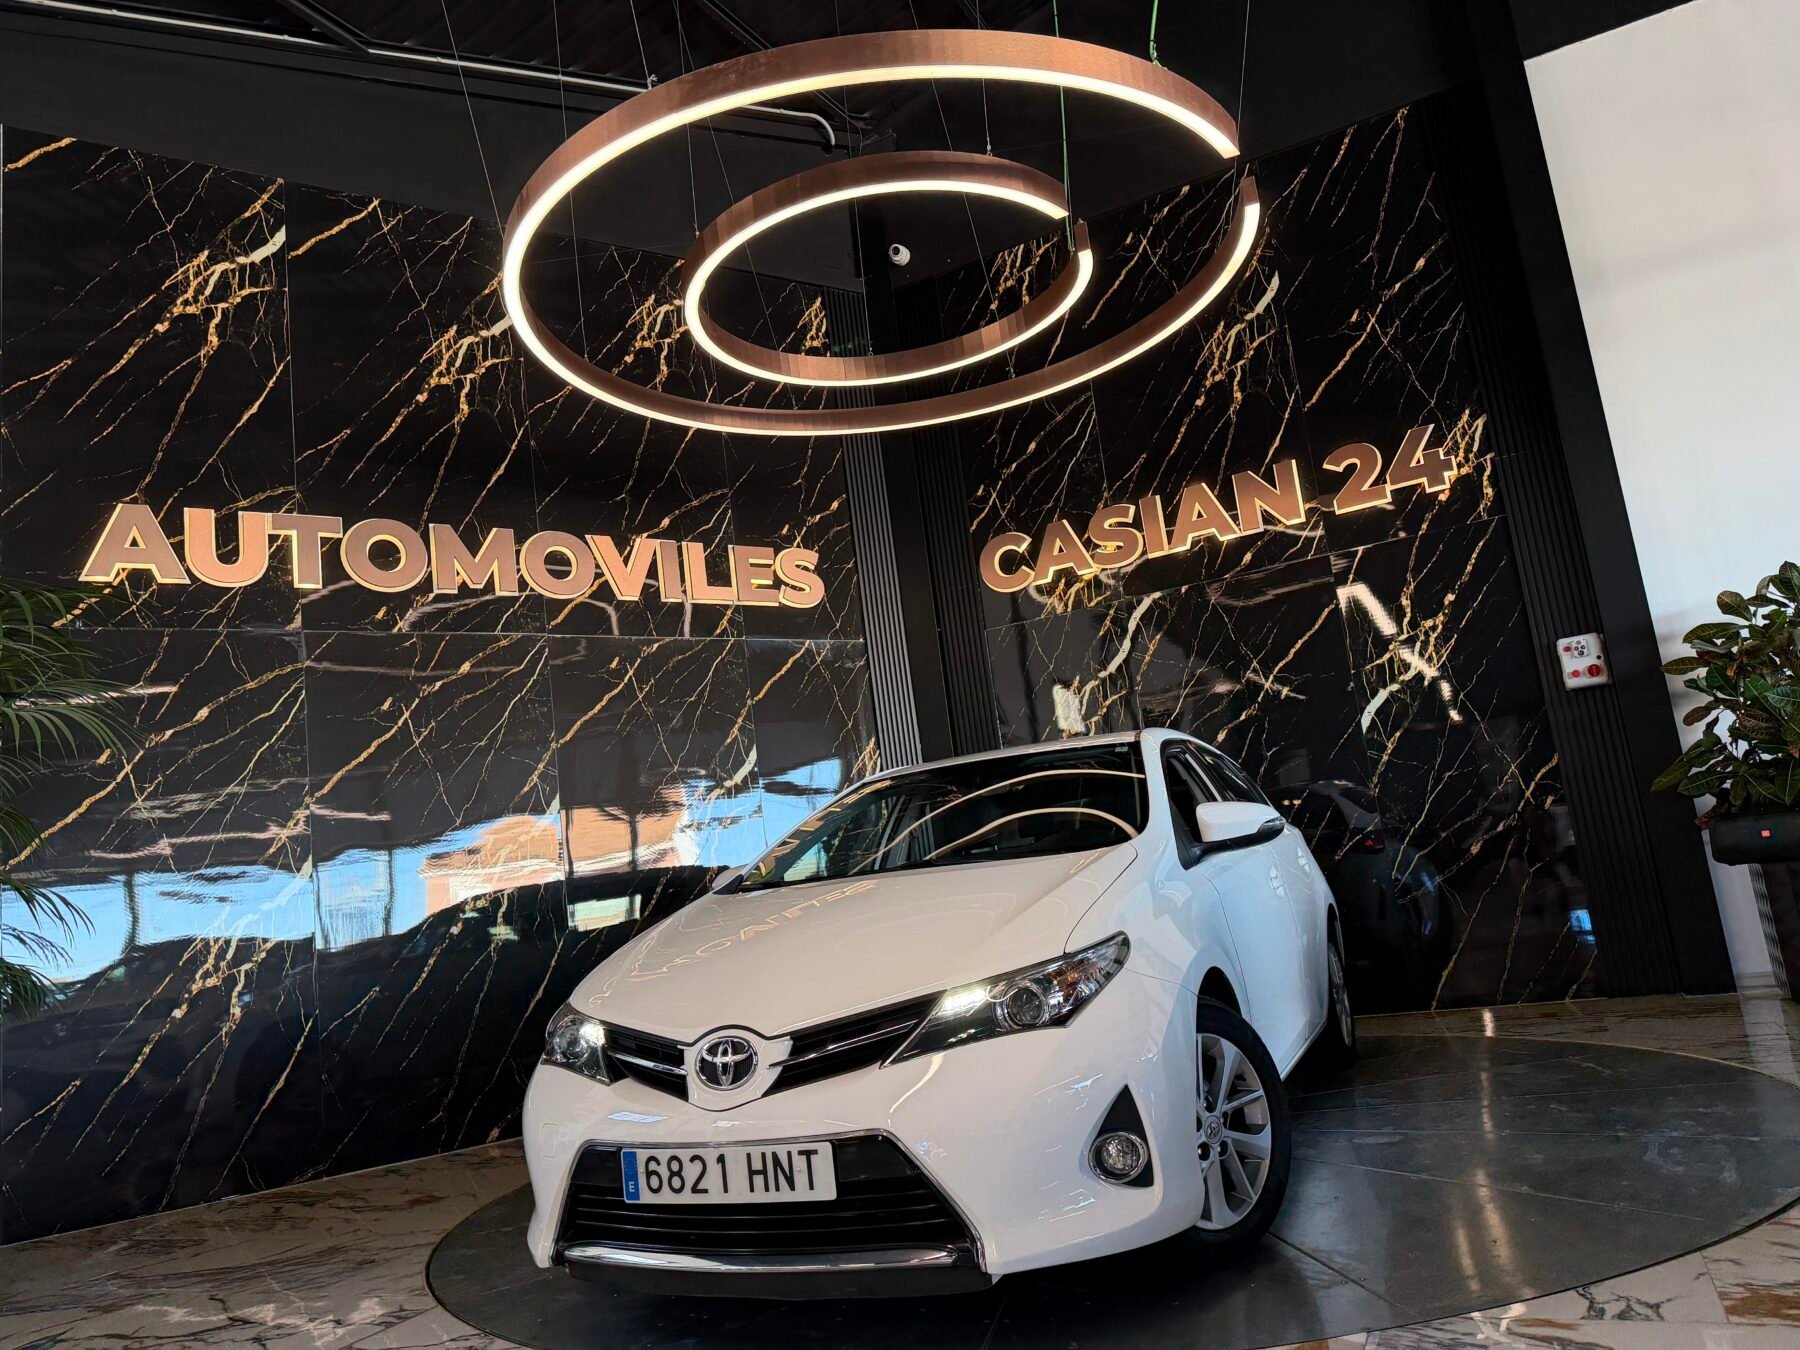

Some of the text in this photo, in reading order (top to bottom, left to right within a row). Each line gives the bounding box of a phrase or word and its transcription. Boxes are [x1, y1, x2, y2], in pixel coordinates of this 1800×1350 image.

[979, 423, 1458, 593] CASIAN 24
[78, 503, 825, 609] AUTOMOVILES
[628, 1181, 636, 1193] E
[644, 1149, 819, 1195] 6821 HNT
